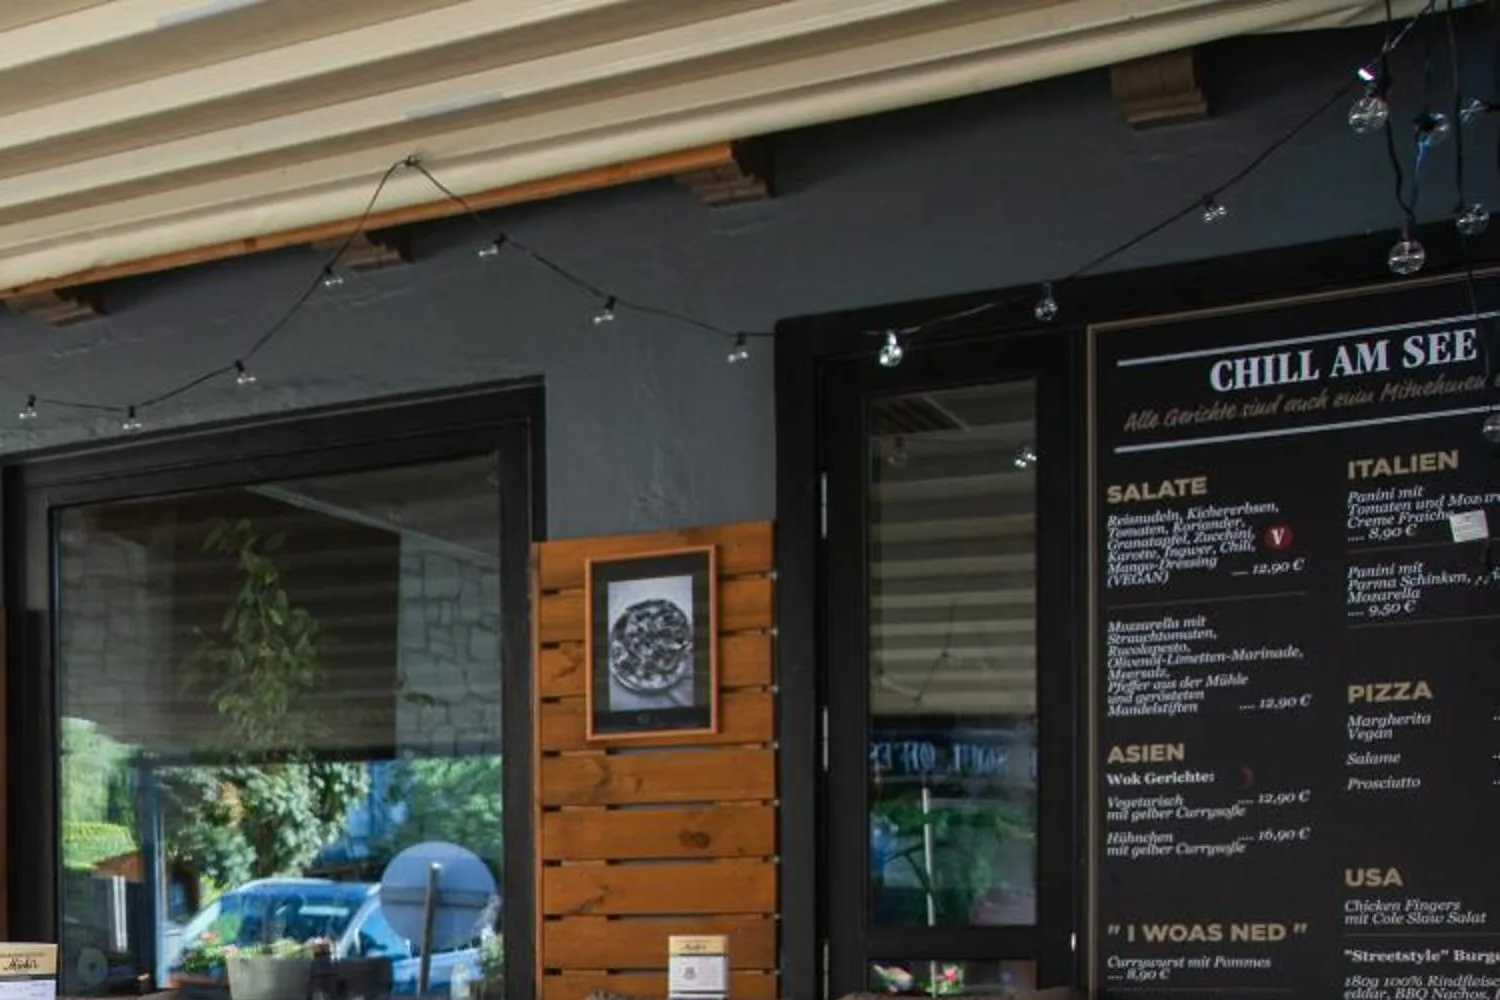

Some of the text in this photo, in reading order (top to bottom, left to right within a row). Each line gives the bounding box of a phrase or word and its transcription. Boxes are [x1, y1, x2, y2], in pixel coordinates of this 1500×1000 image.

[1209, 328, 1477, 392] CHILL AM SEE
[1123, 410, 1160, 432] Alle
[1162, 401, 1237, 428] Gerichte
[1348, 449, 1459, 479] ITALIEN
[1107, 476, 1209, 504] SALATE
[1348, 488, 1396, 504] Panini
[1348, 501, 1412, 517] Tomaten
[1348, 513, 1395, 529] Creme
[1348, 564, 1396, 579] Panini
[1348, 577, 1397, 592] Parma
[1347, 680, 1435, 704] PIZZA
[1348, 712, 1432, 729] Margherita
[1107, 742, 1186, 765] ASIEN
[1106, 771, 1141, 786] Wok
[1347, 775, 1421, 791] Prosciutto
[1345, 866, 1405, 888] USA
[1141, 923, 1224, 943] WOAS
[1231, 922, 1287, 943] NED
